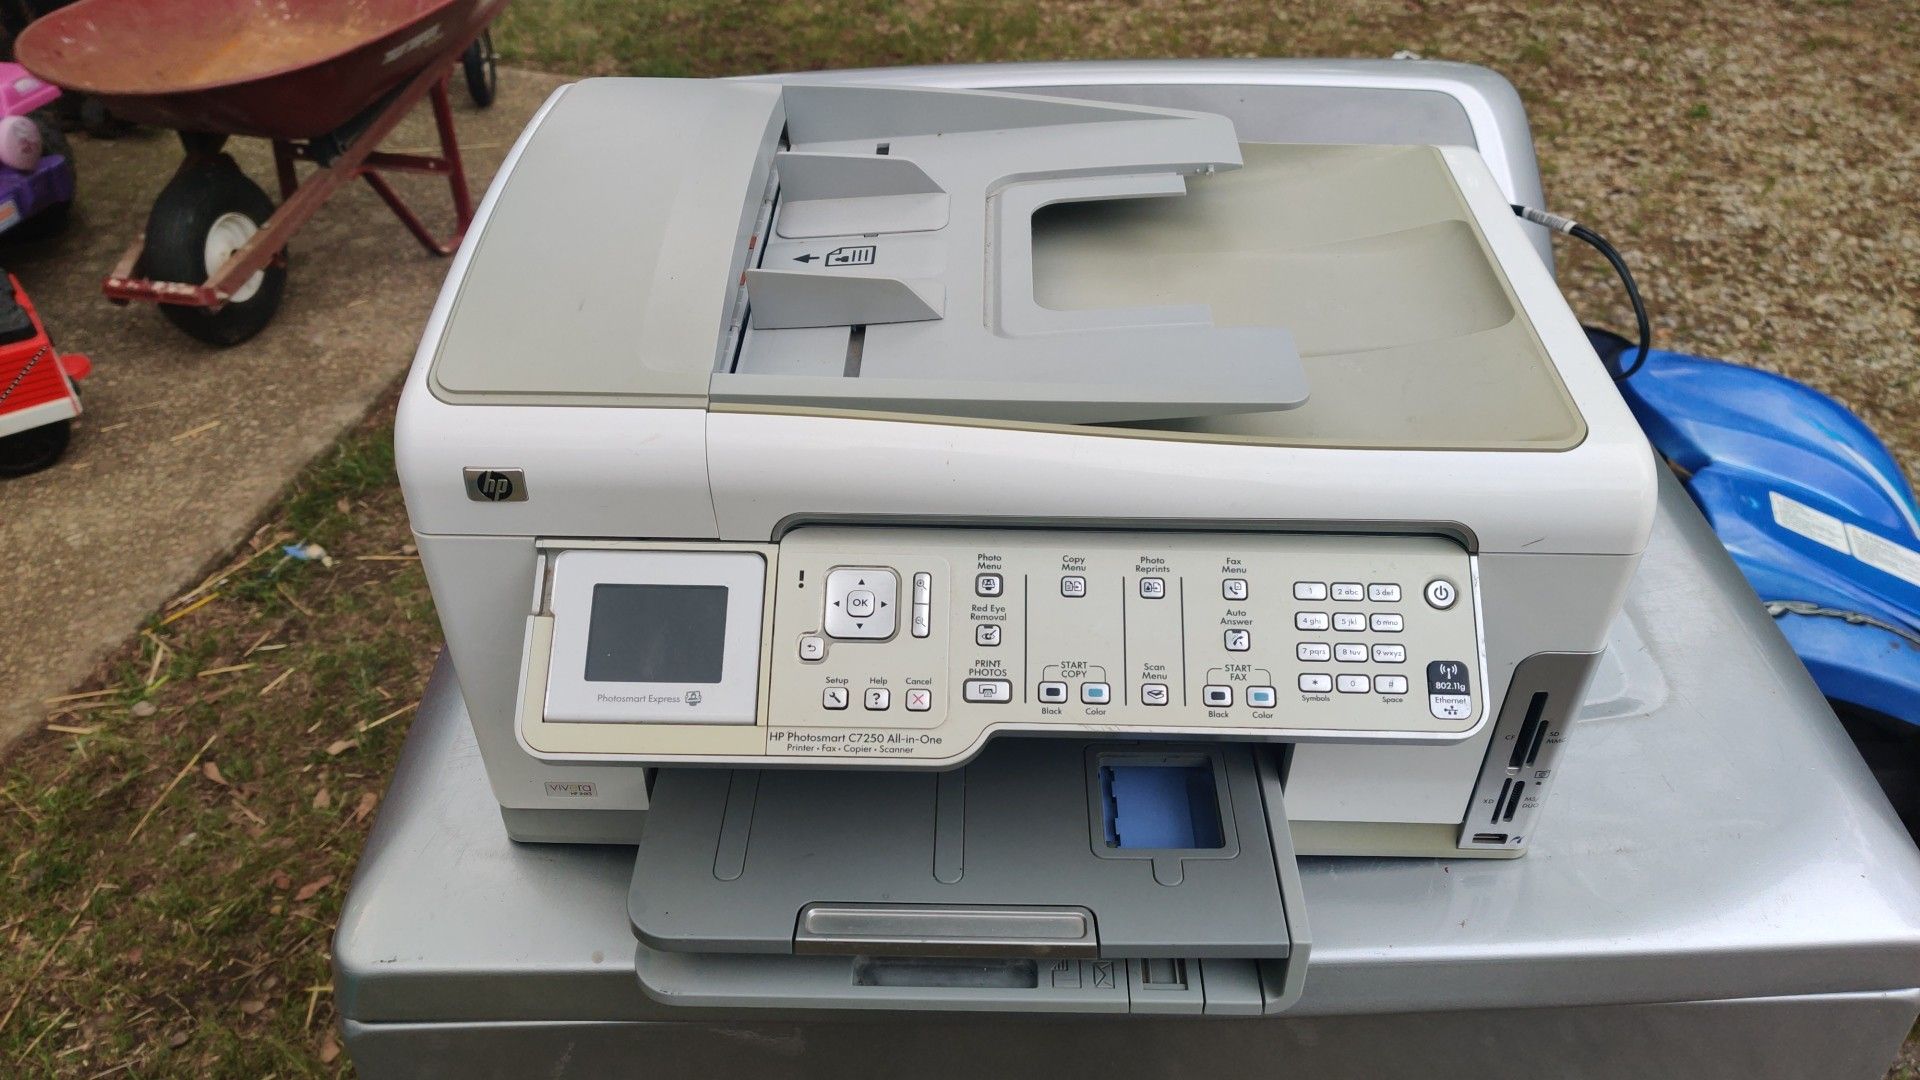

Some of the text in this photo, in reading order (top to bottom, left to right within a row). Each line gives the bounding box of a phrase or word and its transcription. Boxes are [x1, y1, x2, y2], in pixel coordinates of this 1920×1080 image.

[977, 553, 1002, 562] Photo
[1062, 555, 1085, 565] Copy
[1140, 556, 1165, 565] Photo
[1226, 557, 1242, 565] Fax
[977, 562, 1002, 570] Menu
[1061, 563, 1086, 572] Menu
[1135, 564, 1170, 574] Reprints
[1221, 566, 1247, 574] Menu
[1337, 588, 1359, 596] 2 abc
[1375, 588, 1394, 596] 3 def
[852, 597, 868, 608] OK
[971, 604, 1006, 614] Red Eye
[1226, 609, 1247, 617] Auto
[970, 612, 1007, 621] Removal
[1220, 617, 1253, 626] Answer
[1376, 618, 1382, 626] 6
[1302, 647, 1326, 657] 7 pqrs
[1342, 648, 1361, 656] 8 tuv
[1382, 650, 1402, 658] wxyz
[974, 659, 1001, 668] PRINT
[1060, 661, 1088, 669] START
[1144, 663, 1165, 671] Scan
[1224, 664, 1252, 672] START
[969, 668, 1007, 677] PHOTOS
[1061, 670, 1087, 678] COPY
[1142, 671, 1168, 680] Menu
[1229, 673, 1247, 681] FAX
[825, 676, 849, 686] Setup
[869, 676, 888, 686] Help
[905, 677, 932, 685] Cancel
[1435, 681, 1466, 692] 802.11g
[597, 693, 681, 706] Photosmart Express
[1301, 694, 1331, 703] Symbols
[1382, 695, 1403, 705] Space
[1434, 695, 1467, 705] Ethernet
[1041, 707, 1062, 716] Black
[1085, 707, 1106, 716] Color
[1208, 710, 1229, 719] Black
[1252, 711, 1274, 719] Color
[769, 732, 943, 745] HP Photosmart C7250 All-in-One
[787, 744, 914, 755] Printer Fax Copier Scanner
